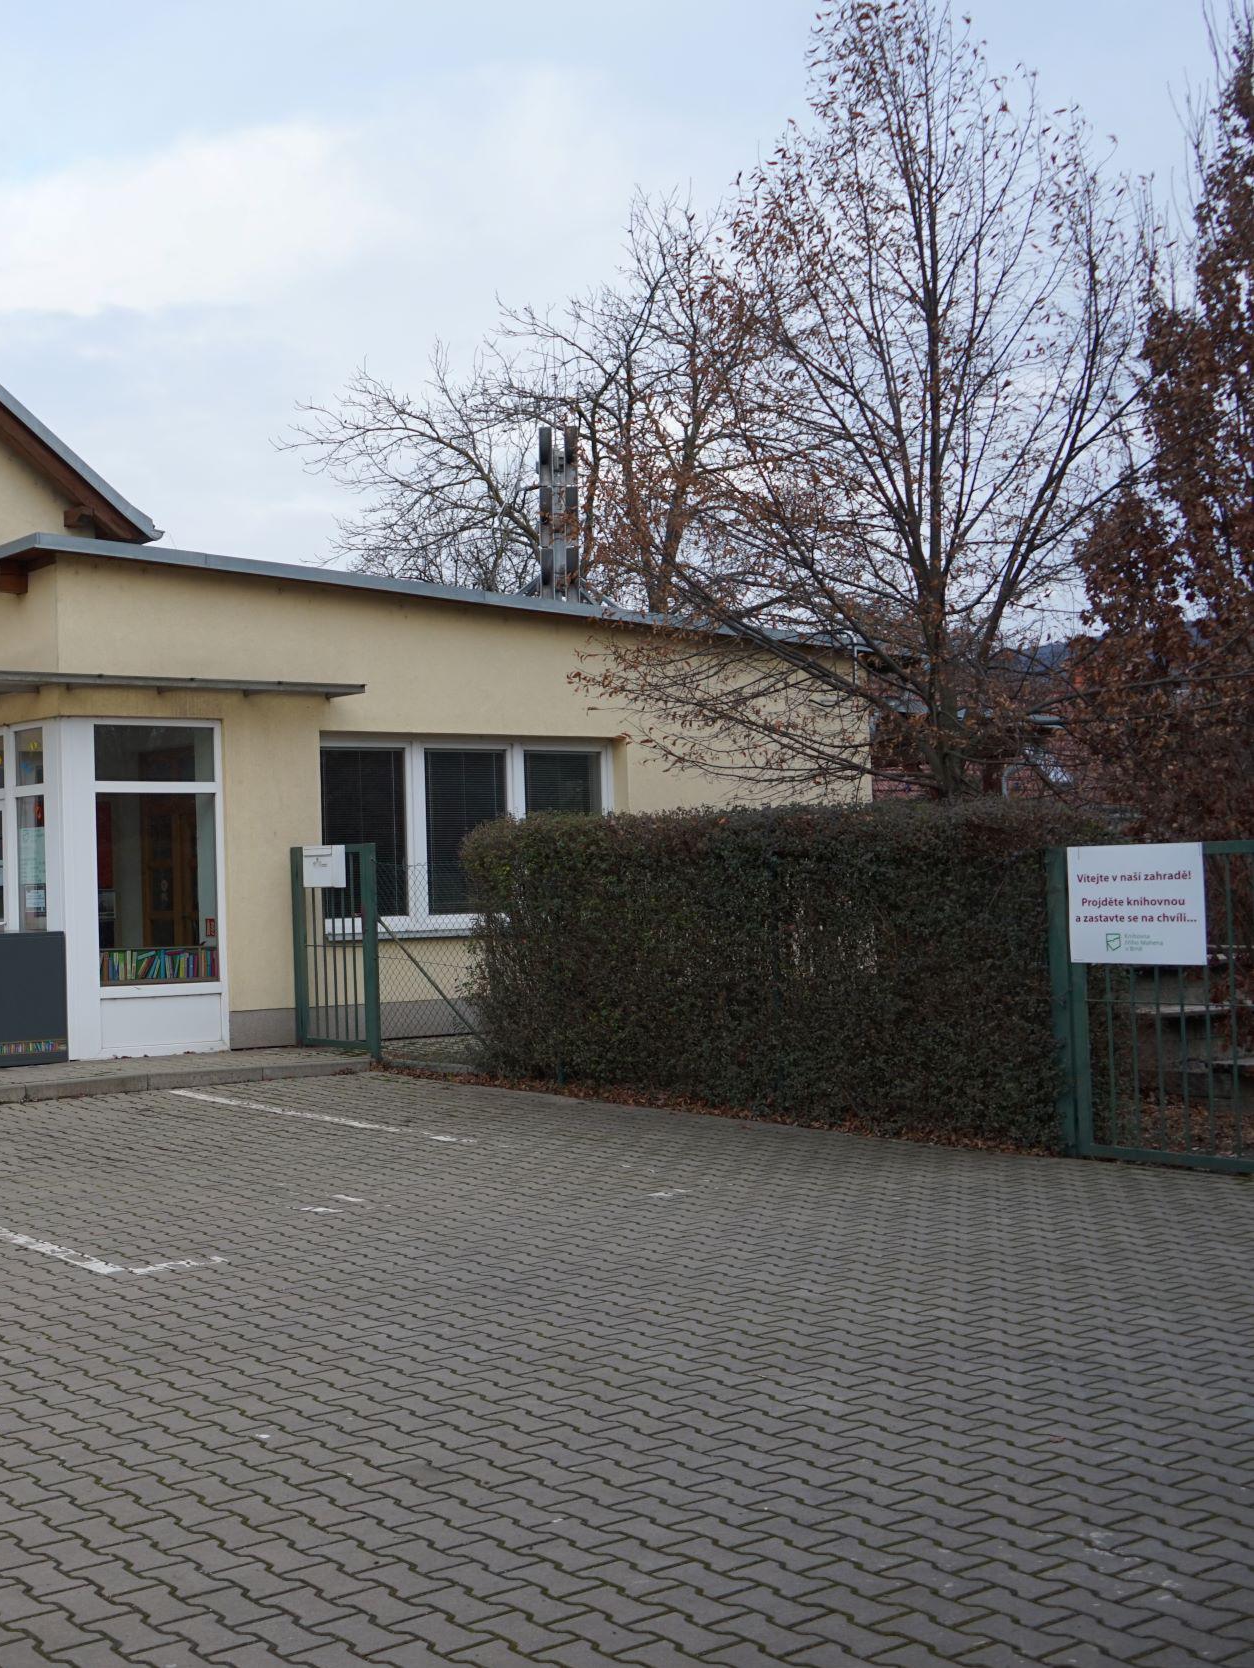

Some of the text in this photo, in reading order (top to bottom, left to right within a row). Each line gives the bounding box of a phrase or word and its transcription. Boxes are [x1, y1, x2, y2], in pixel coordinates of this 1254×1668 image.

[1112, 874, 1118, 882] v
[1120, 872, 1142, 881] naší
[1143, 870, 1192, 881] zahradě!
[1081, 896, 1186, 908] Projděte knihovnou
[1083, 914, 1125, 922] zastavte
